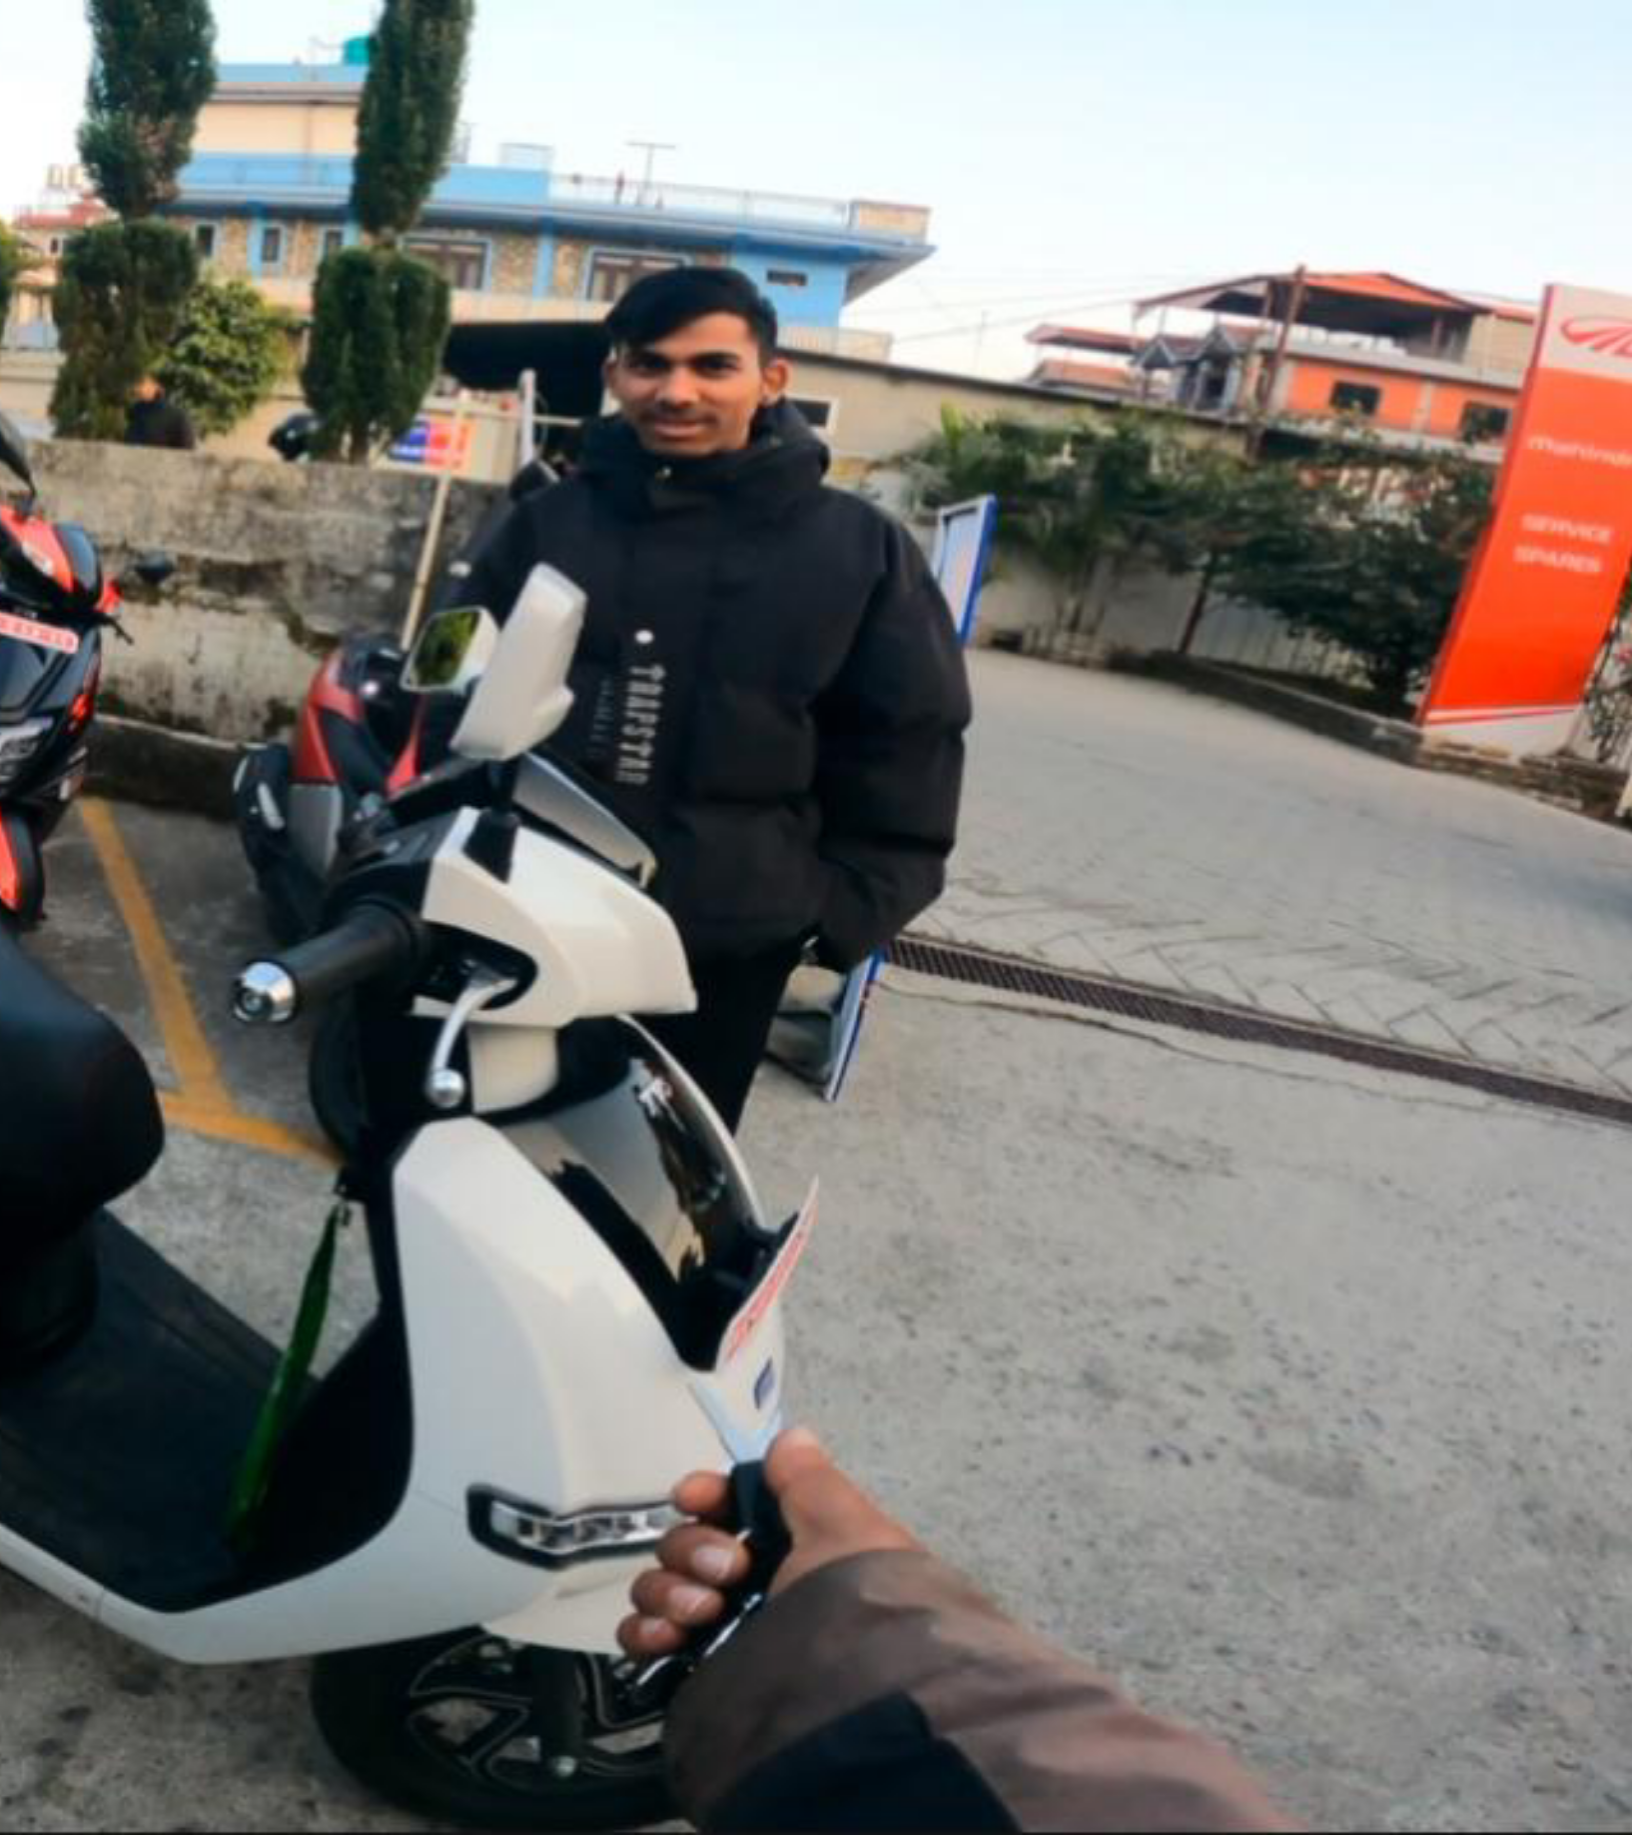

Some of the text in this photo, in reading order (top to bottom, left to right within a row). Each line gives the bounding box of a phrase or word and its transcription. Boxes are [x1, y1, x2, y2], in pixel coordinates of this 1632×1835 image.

[1520, 513, 1613, 544] SERVICE
[1512, 544, 1603, 573] SPARES
[614, 662, 667, 787] TRAPSTAR
